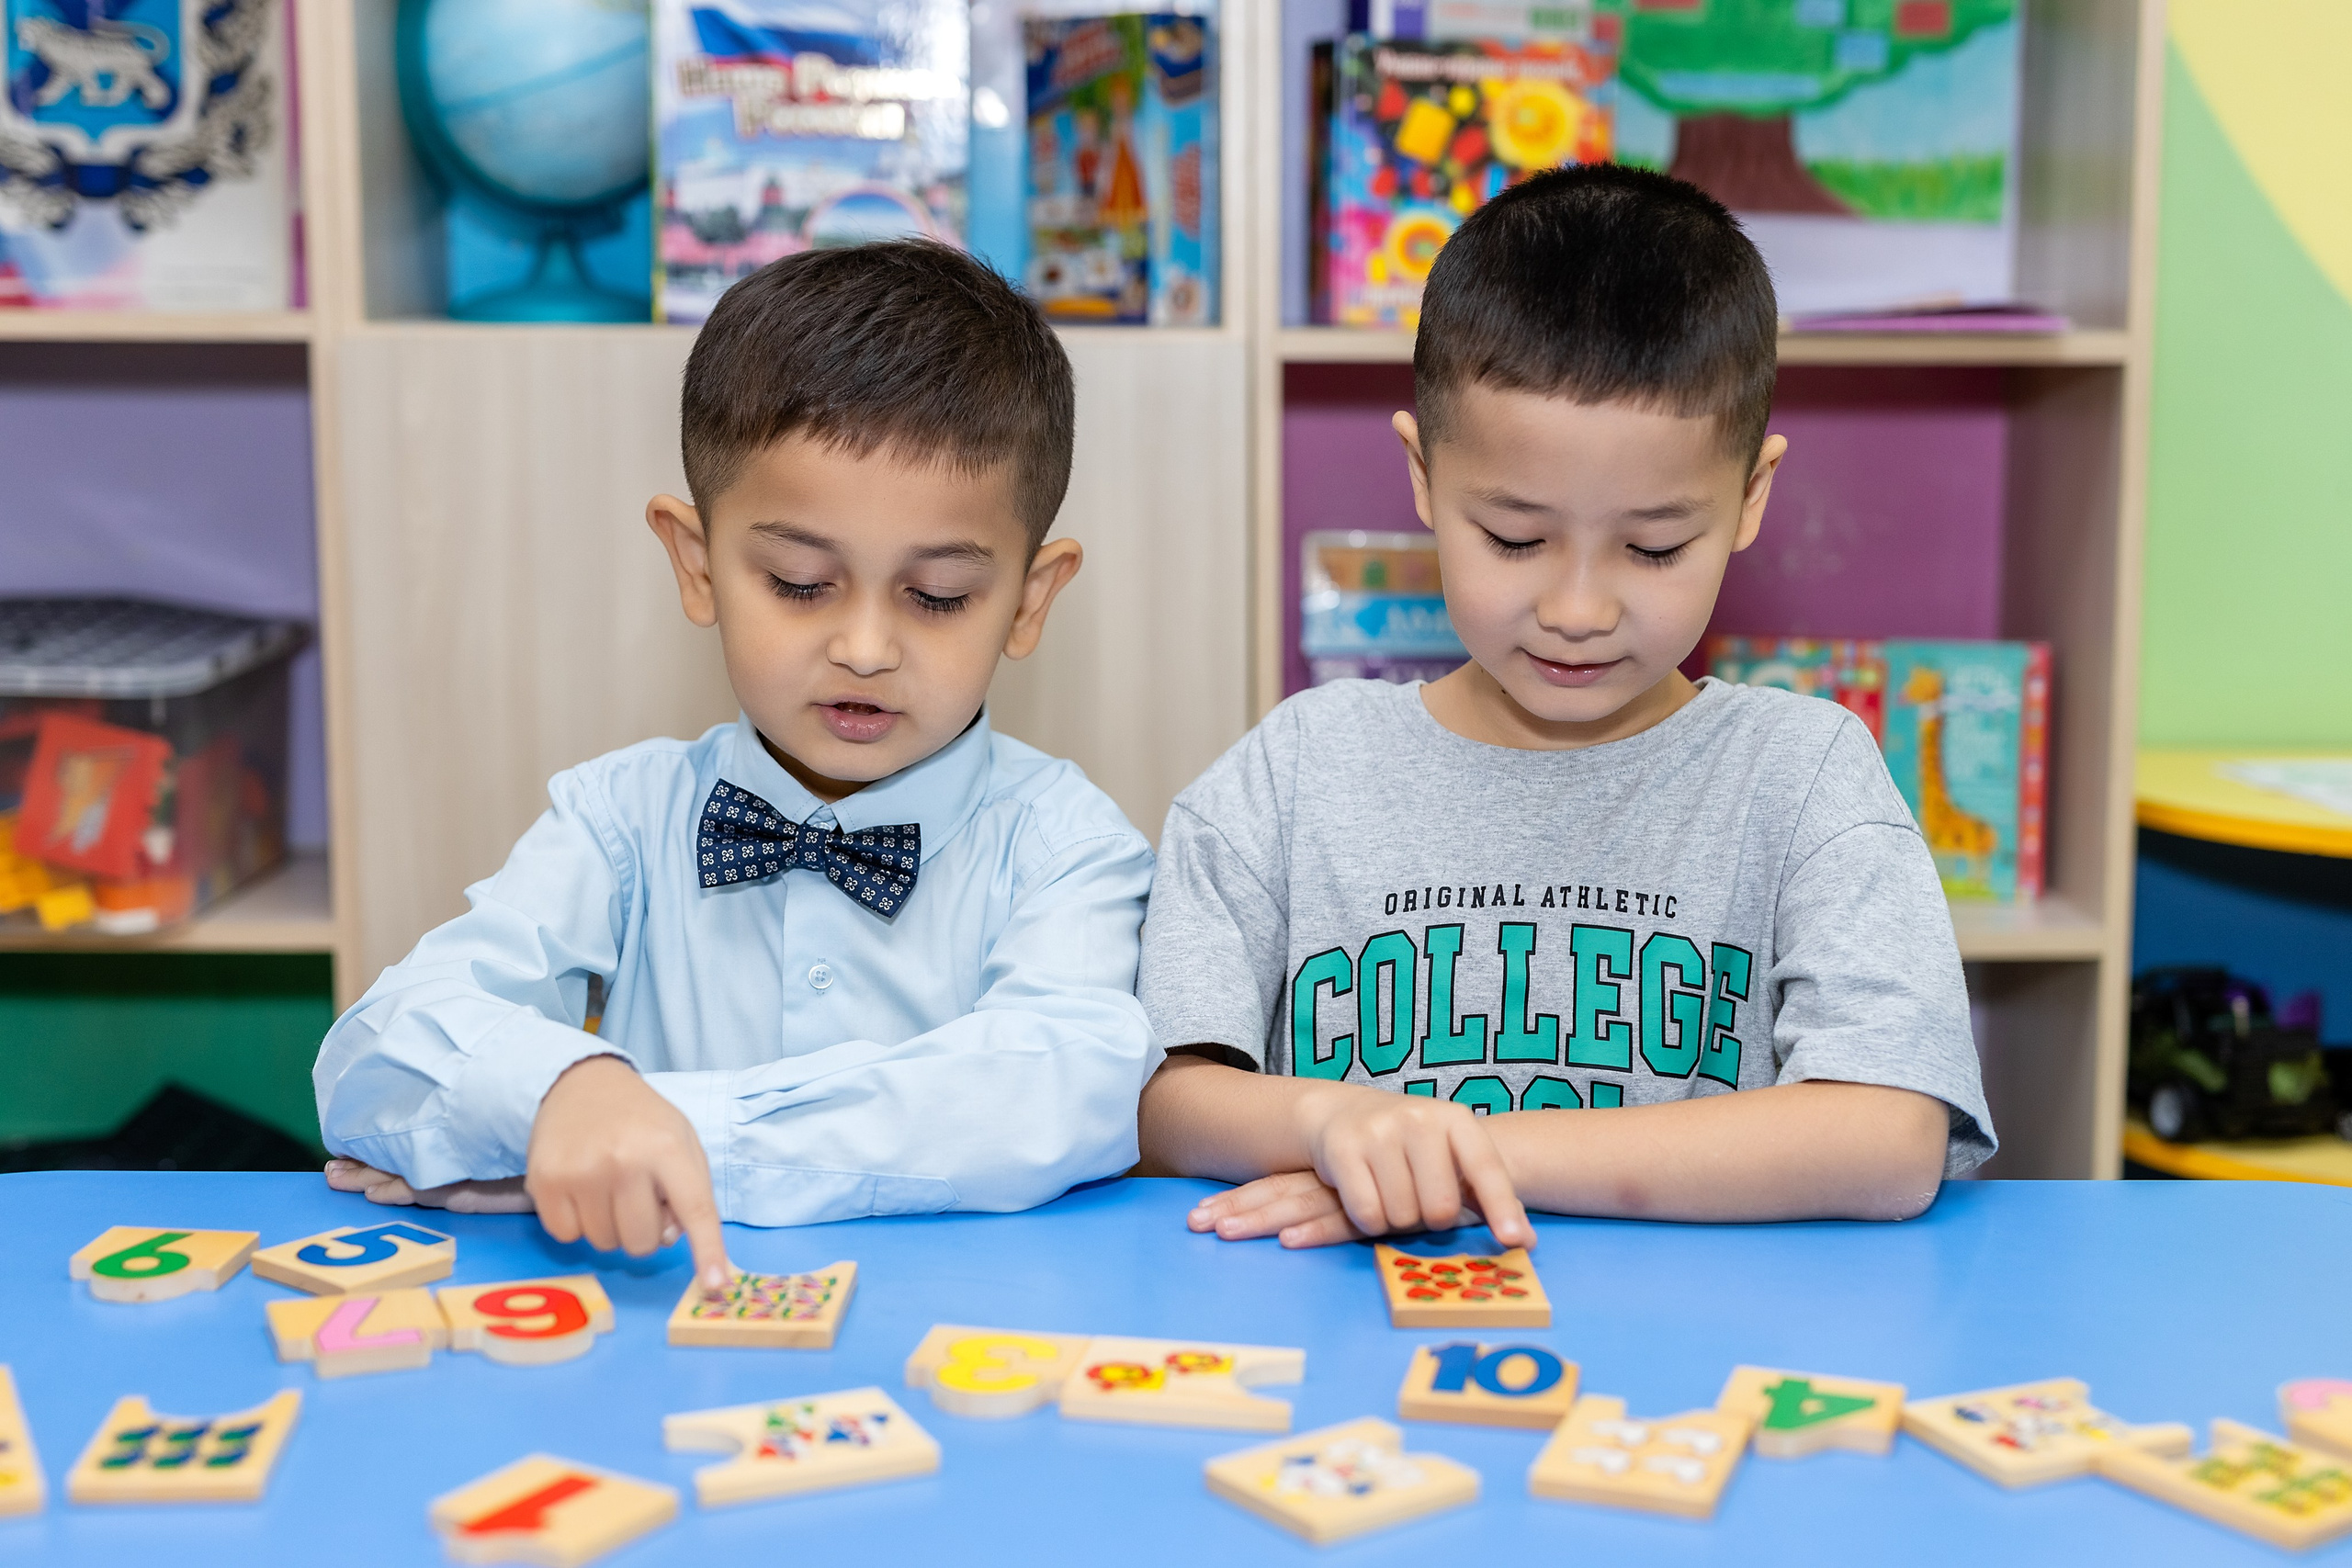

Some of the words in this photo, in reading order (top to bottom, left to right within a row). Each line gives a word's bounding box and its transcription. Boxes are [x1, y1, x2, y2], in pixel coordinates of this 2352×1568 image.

[1385, 884, 1525, 915] ORIGINAL
[1541, 885, 1678, 919] ATHLETIC
[1292, 921, 1753, 1091] COLLEGE
[297, 1223, 450, 1266] 5
[316, 1297, 423, 1353] 7
[937, 1335, 1058, 1393] 3
[1430, 1343, 1564, 1396] 10
[1763, 1379, 1875, 1430] 4
